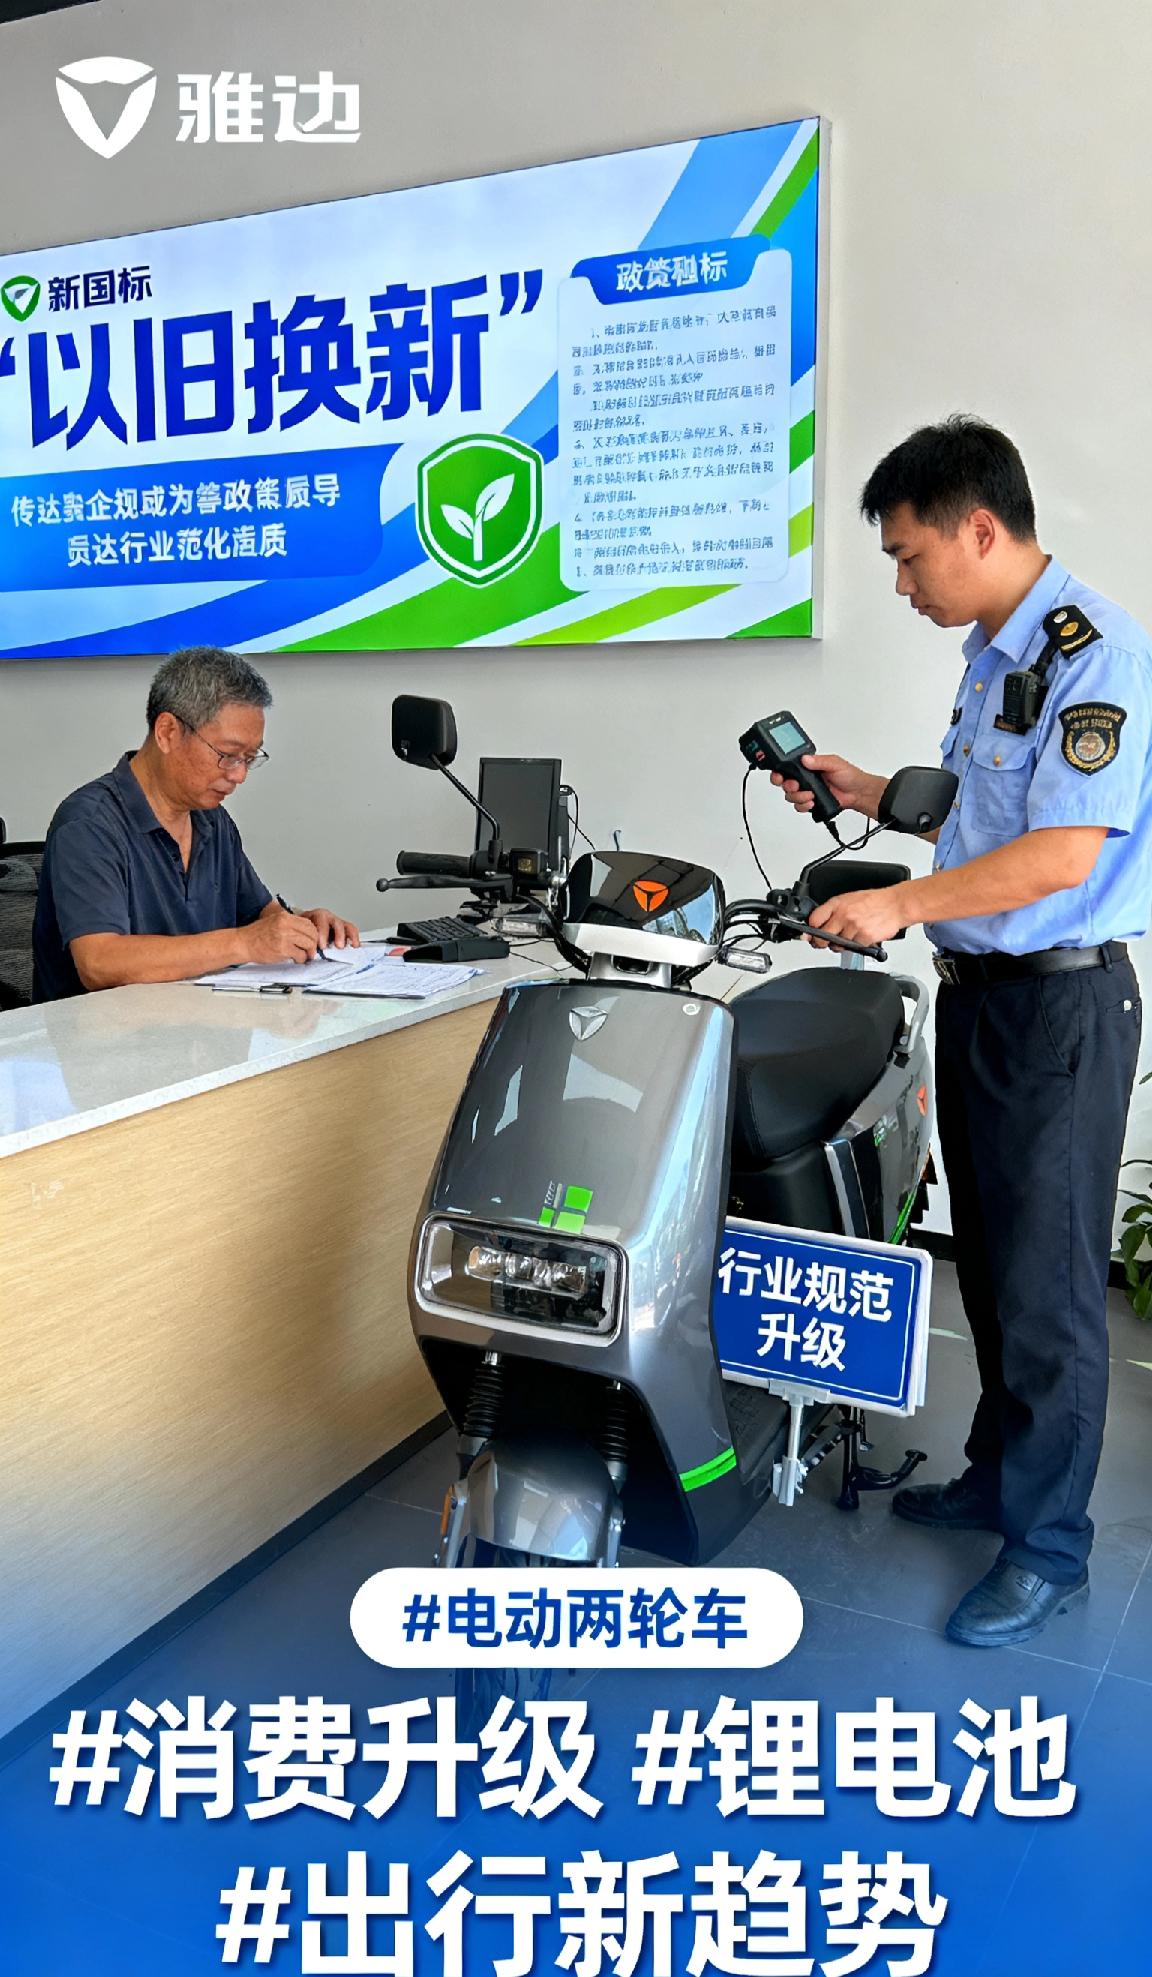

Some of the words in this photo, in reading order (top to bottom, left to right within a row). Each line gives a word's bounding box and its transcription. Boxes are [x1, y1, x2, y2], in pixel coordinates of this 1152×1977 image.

[48, 265, 153, 312] 新国标
[718, 1247, 894, 1322] 行业规范
[756, 1313, 847, 1372] 升级
